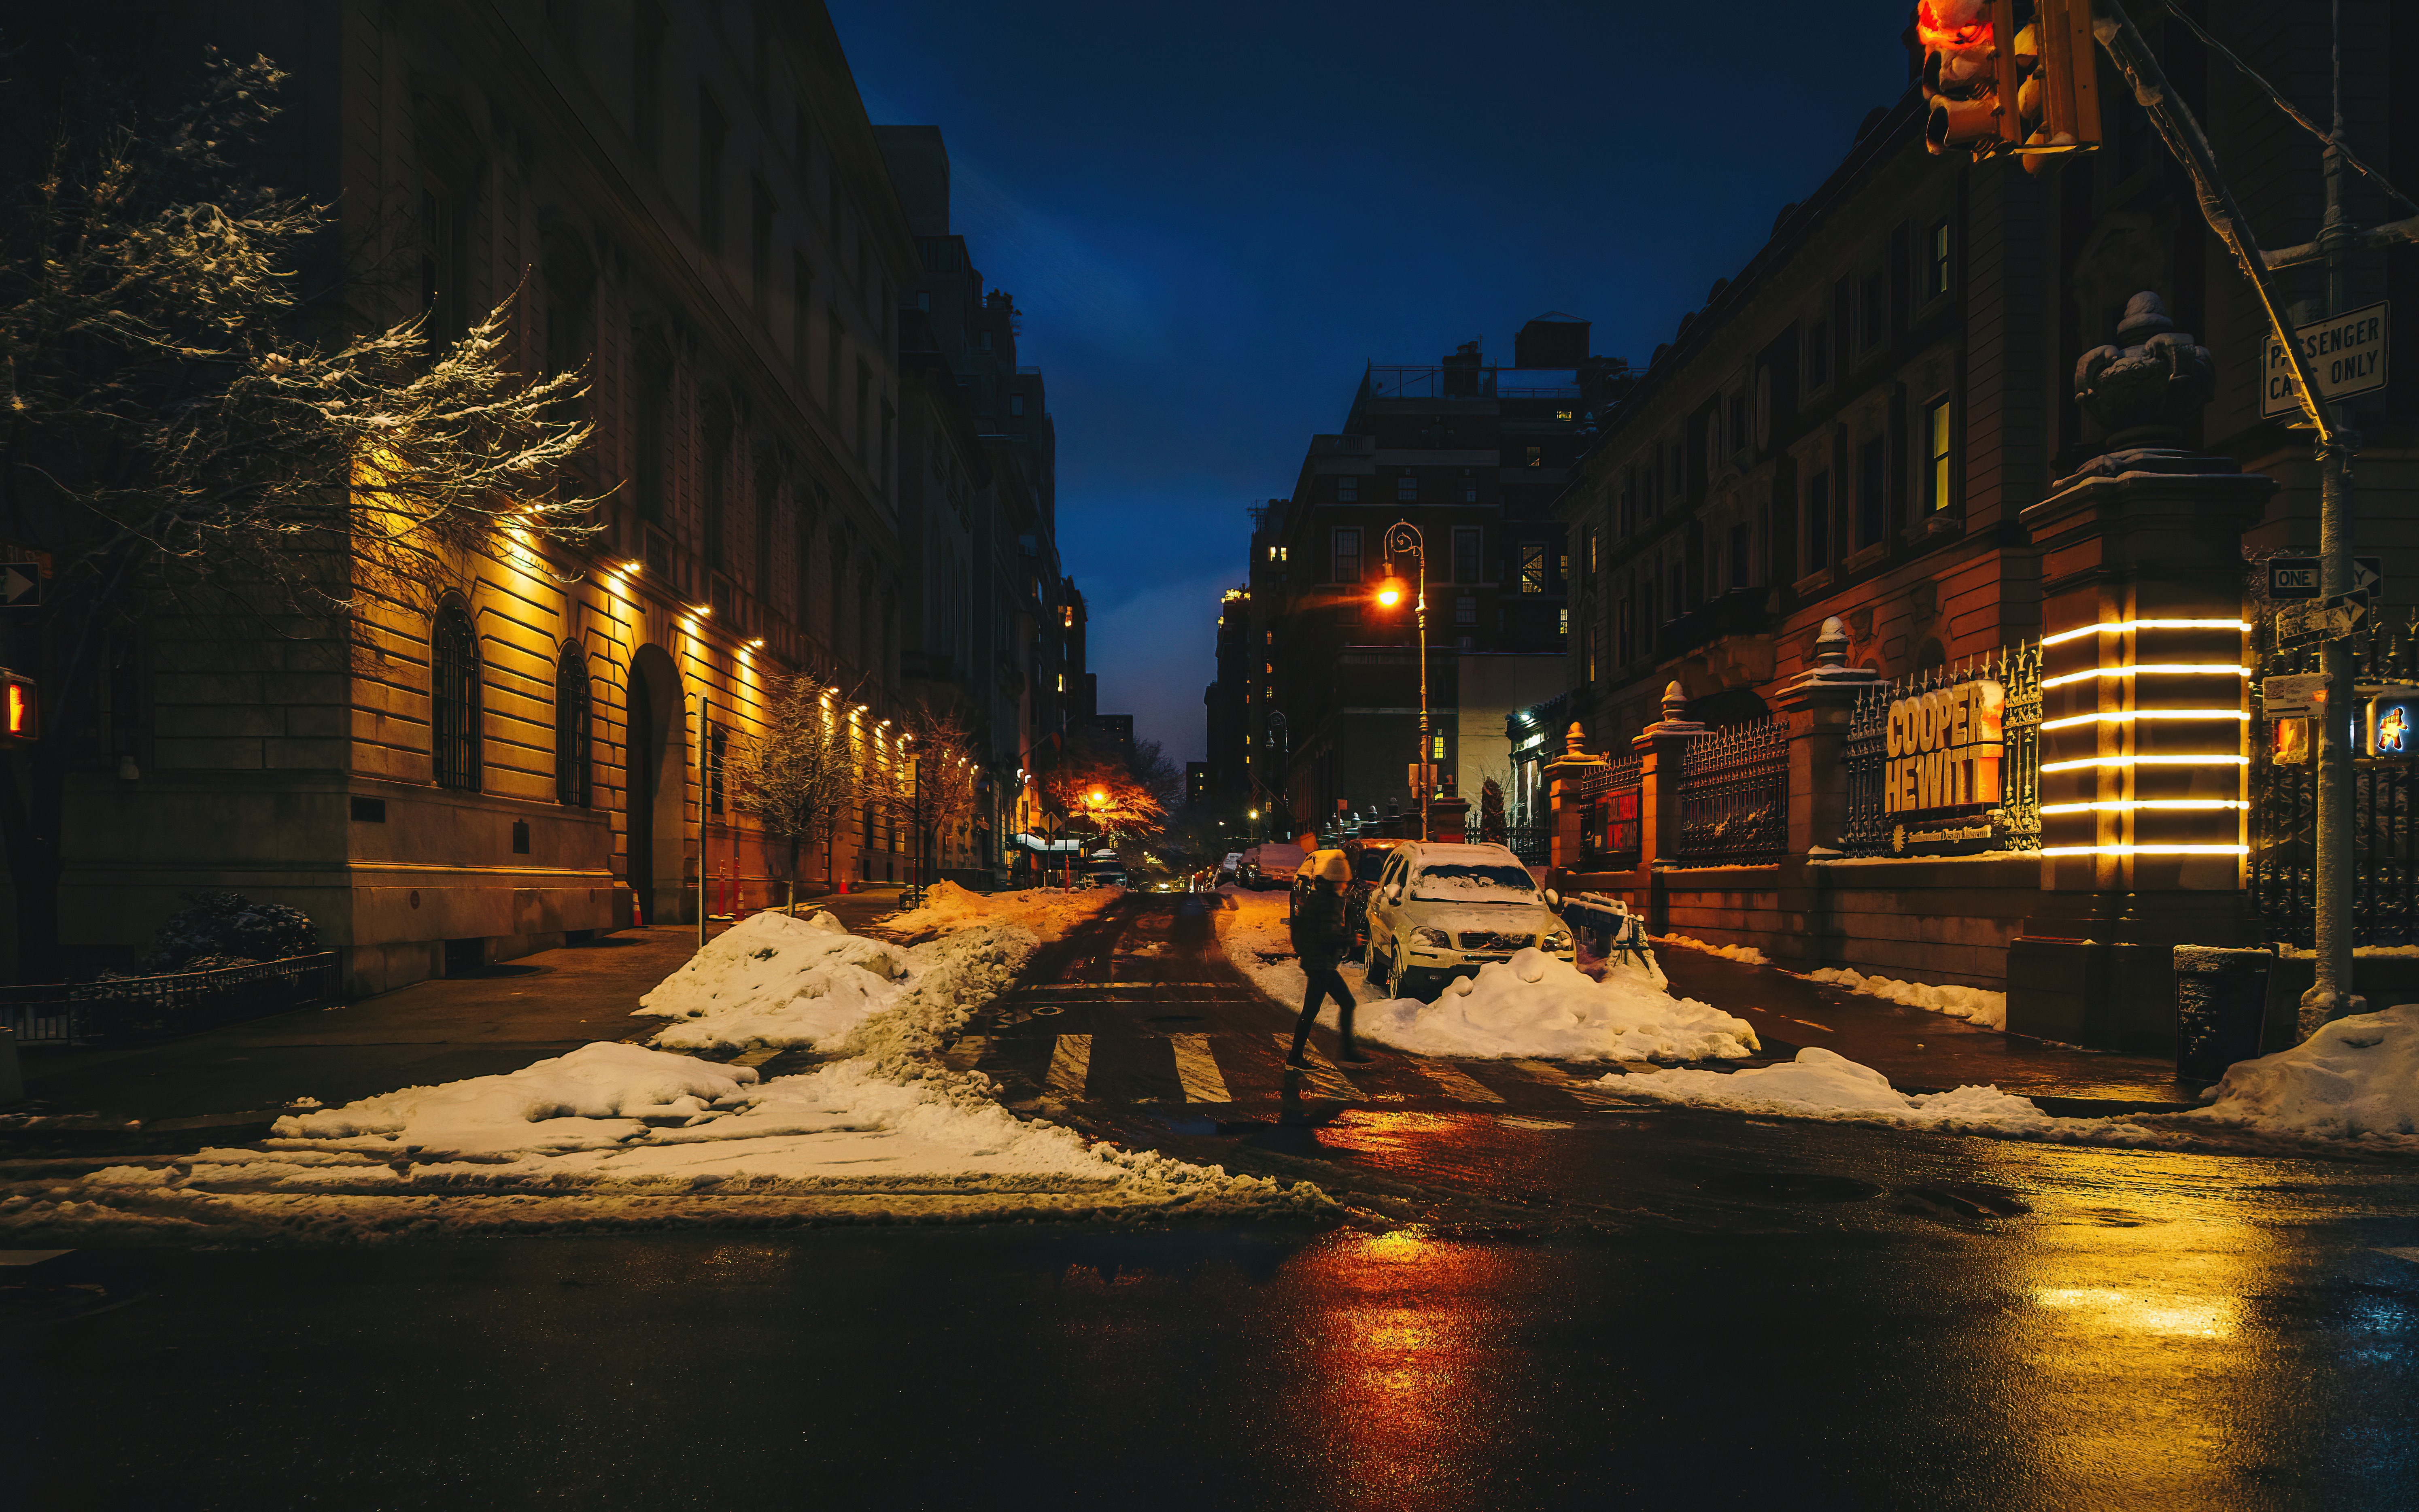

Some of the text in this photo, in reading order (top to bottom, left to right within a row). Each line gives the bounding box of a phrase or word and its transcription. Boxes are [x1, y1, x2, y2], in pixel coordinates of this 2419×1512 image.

[2270, 317, 2379, 369] PSENGER
[2332, 349, 2379, 384] ONLY
[2278, 570, 2312, 586] ONE
[1887, 687, 1984, 758] COOPER
[1884, 743, 1984, 813] HEWITT
